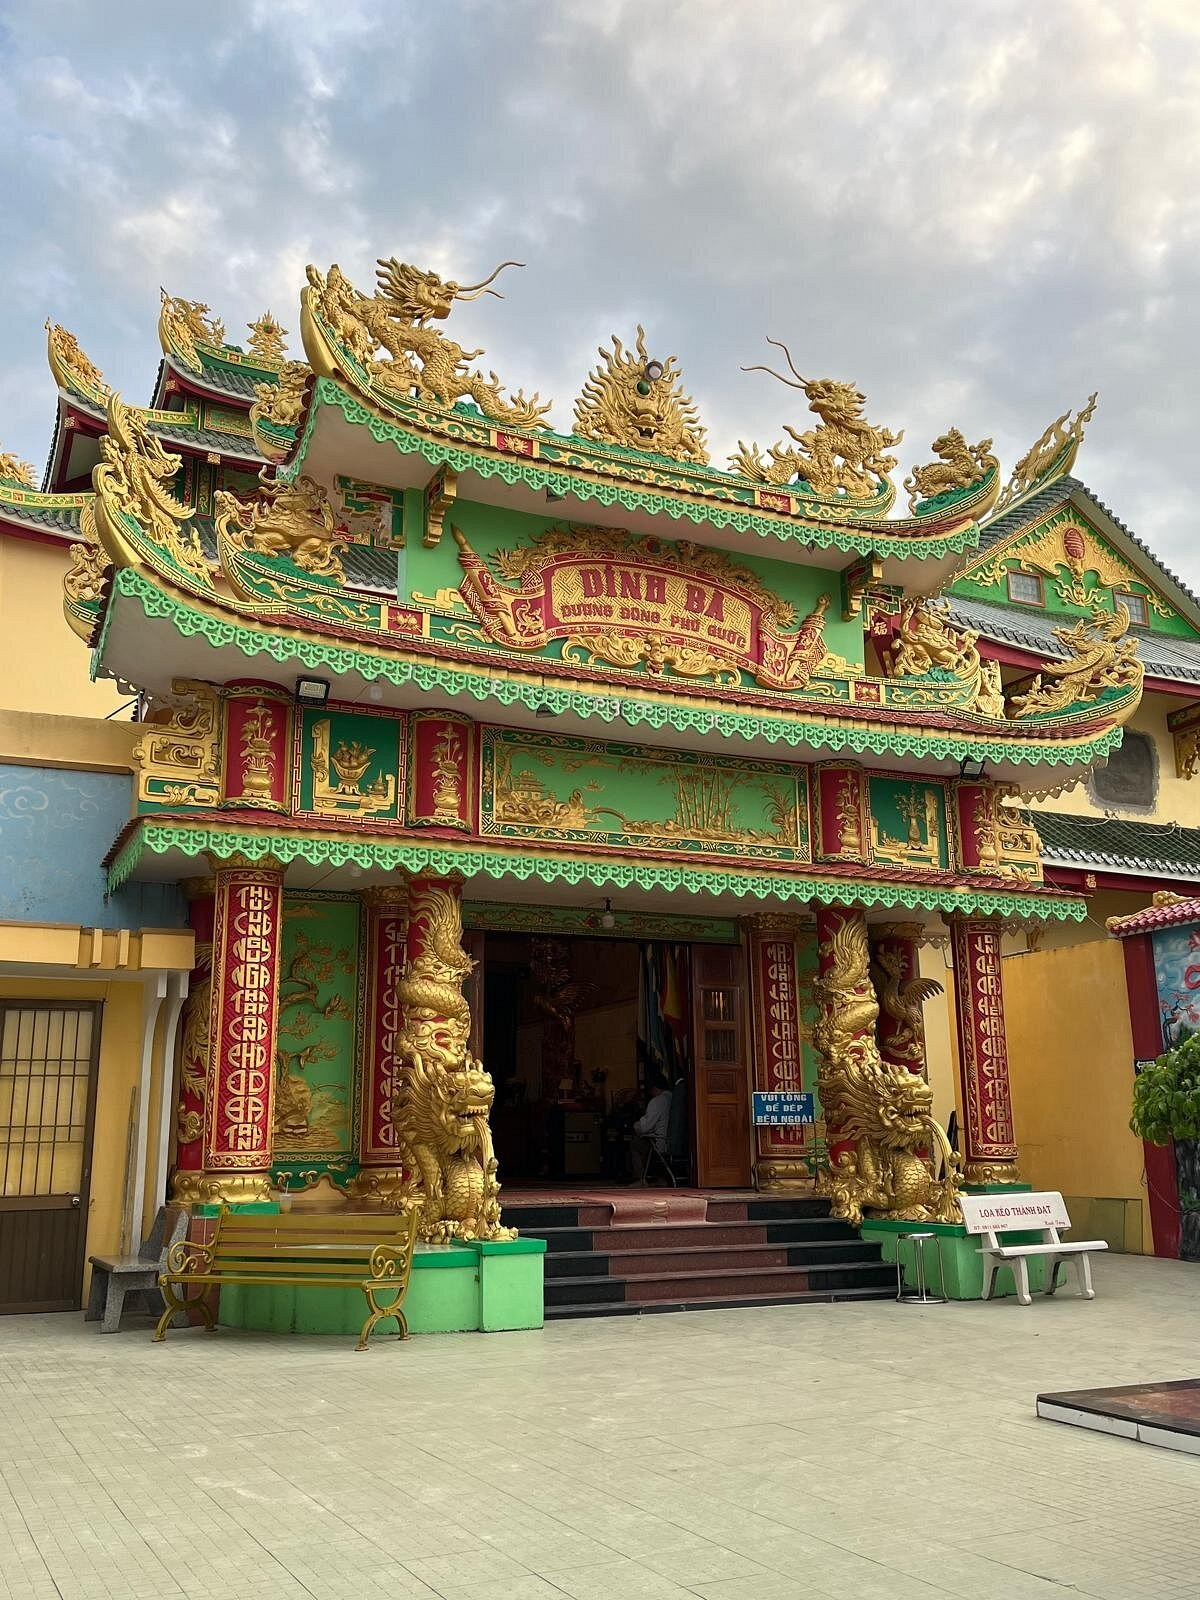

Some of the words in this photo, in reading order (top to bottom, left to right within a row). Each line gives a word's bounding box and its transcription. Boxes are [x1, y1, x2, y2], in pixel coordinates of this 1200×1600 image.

[760, 1094, 778, 1102] VUI
[756, 1114, 778, 1123] BÊN
[979, 1209, 995, 1218] LOA
